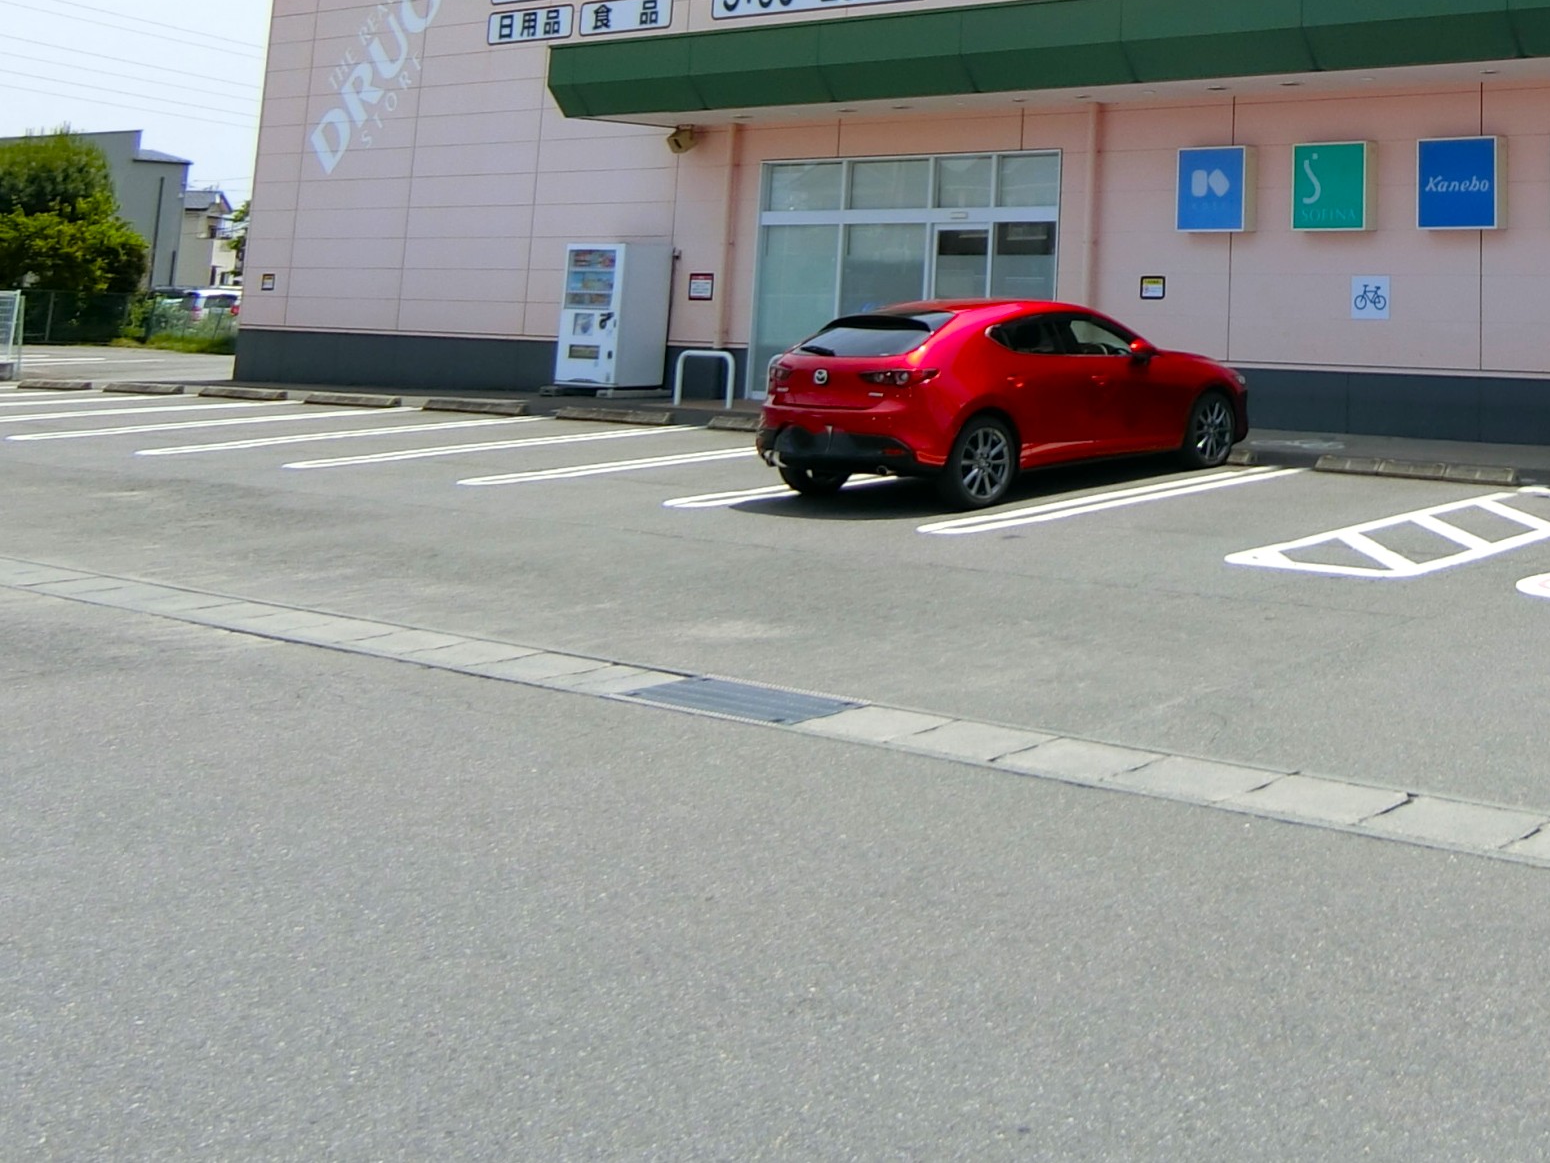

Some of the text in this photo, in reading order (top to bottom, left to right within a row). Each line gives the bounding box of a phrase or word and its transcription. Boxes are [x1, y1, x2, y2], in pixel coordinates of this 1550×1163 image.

[499, 9, 560, 40] 日用品
[592, 0, 658, 30] 食品
[361, 50, 422, 148] STORE
[1425, 175, 1489, 192] Kanebo
[1302, 208, 1357, 222] SOFINA
